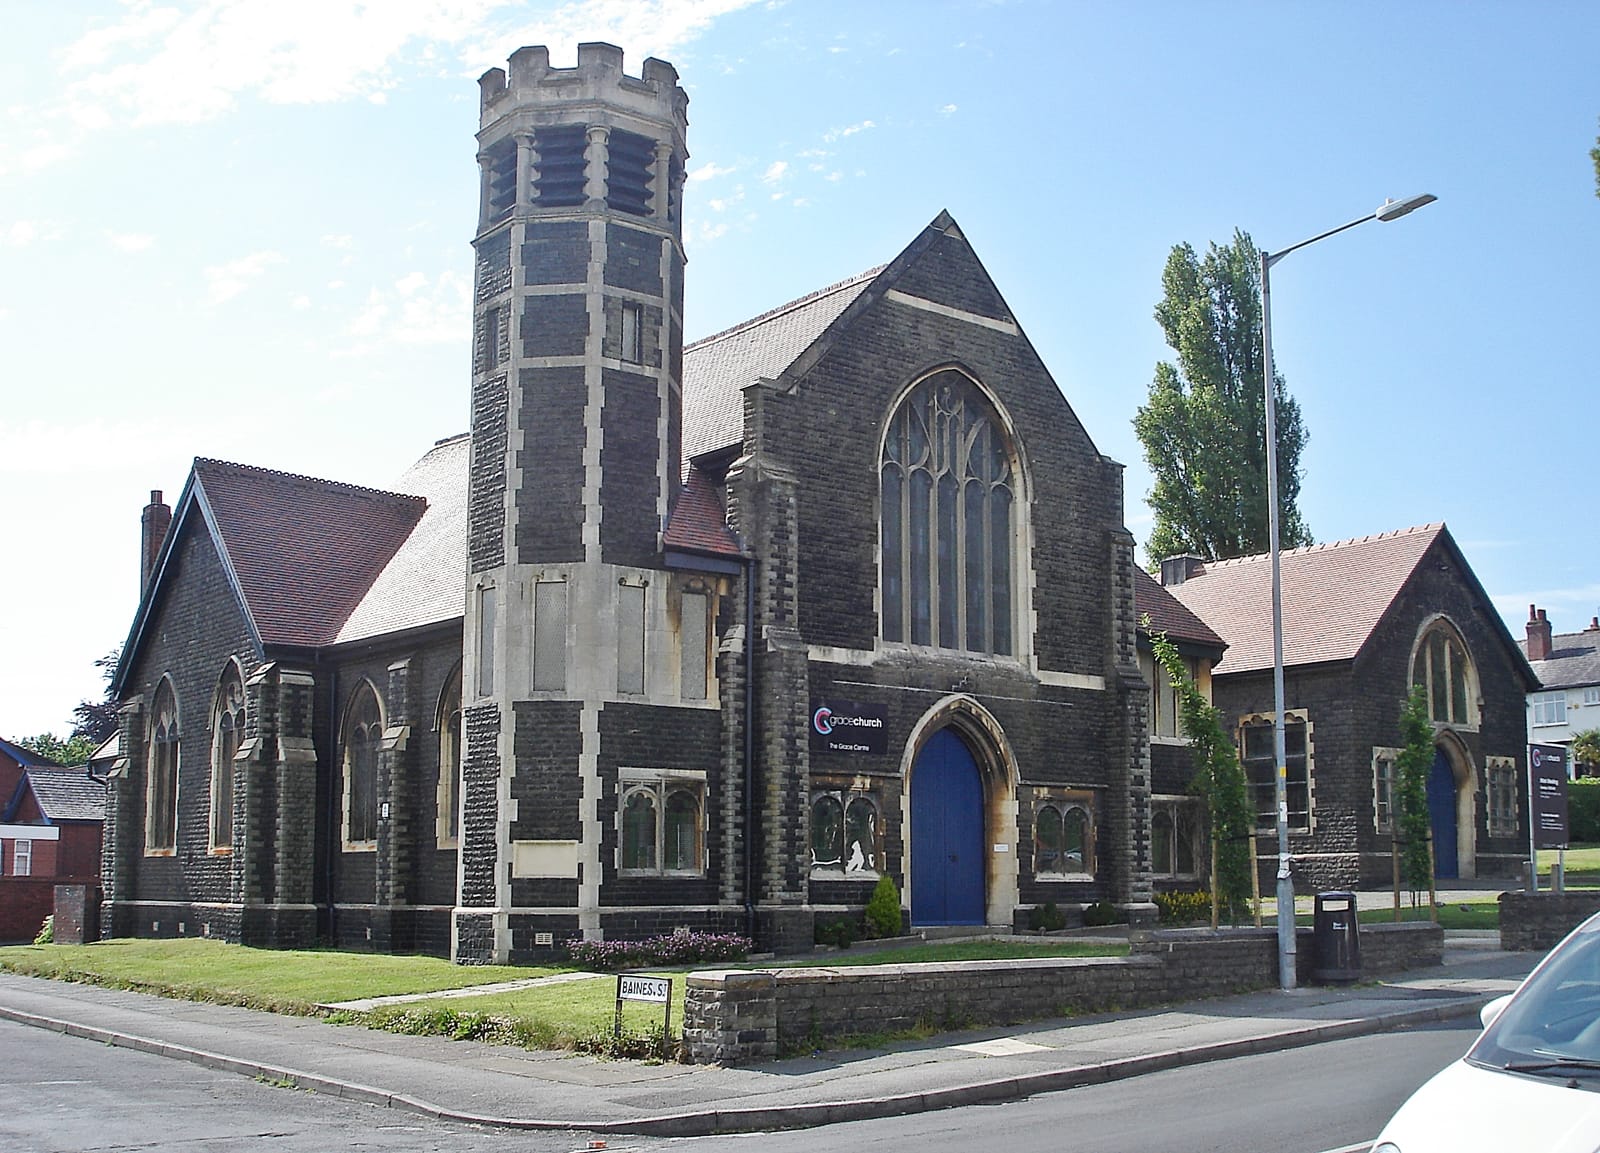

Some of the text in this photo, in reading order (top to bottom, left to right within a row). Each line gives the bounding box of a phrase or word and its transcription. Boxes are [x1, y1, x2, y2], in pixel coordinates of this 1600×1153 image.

[829, 716, 882, 728] gracechurch
[829, 742, 870, 752] The Grace Centre
